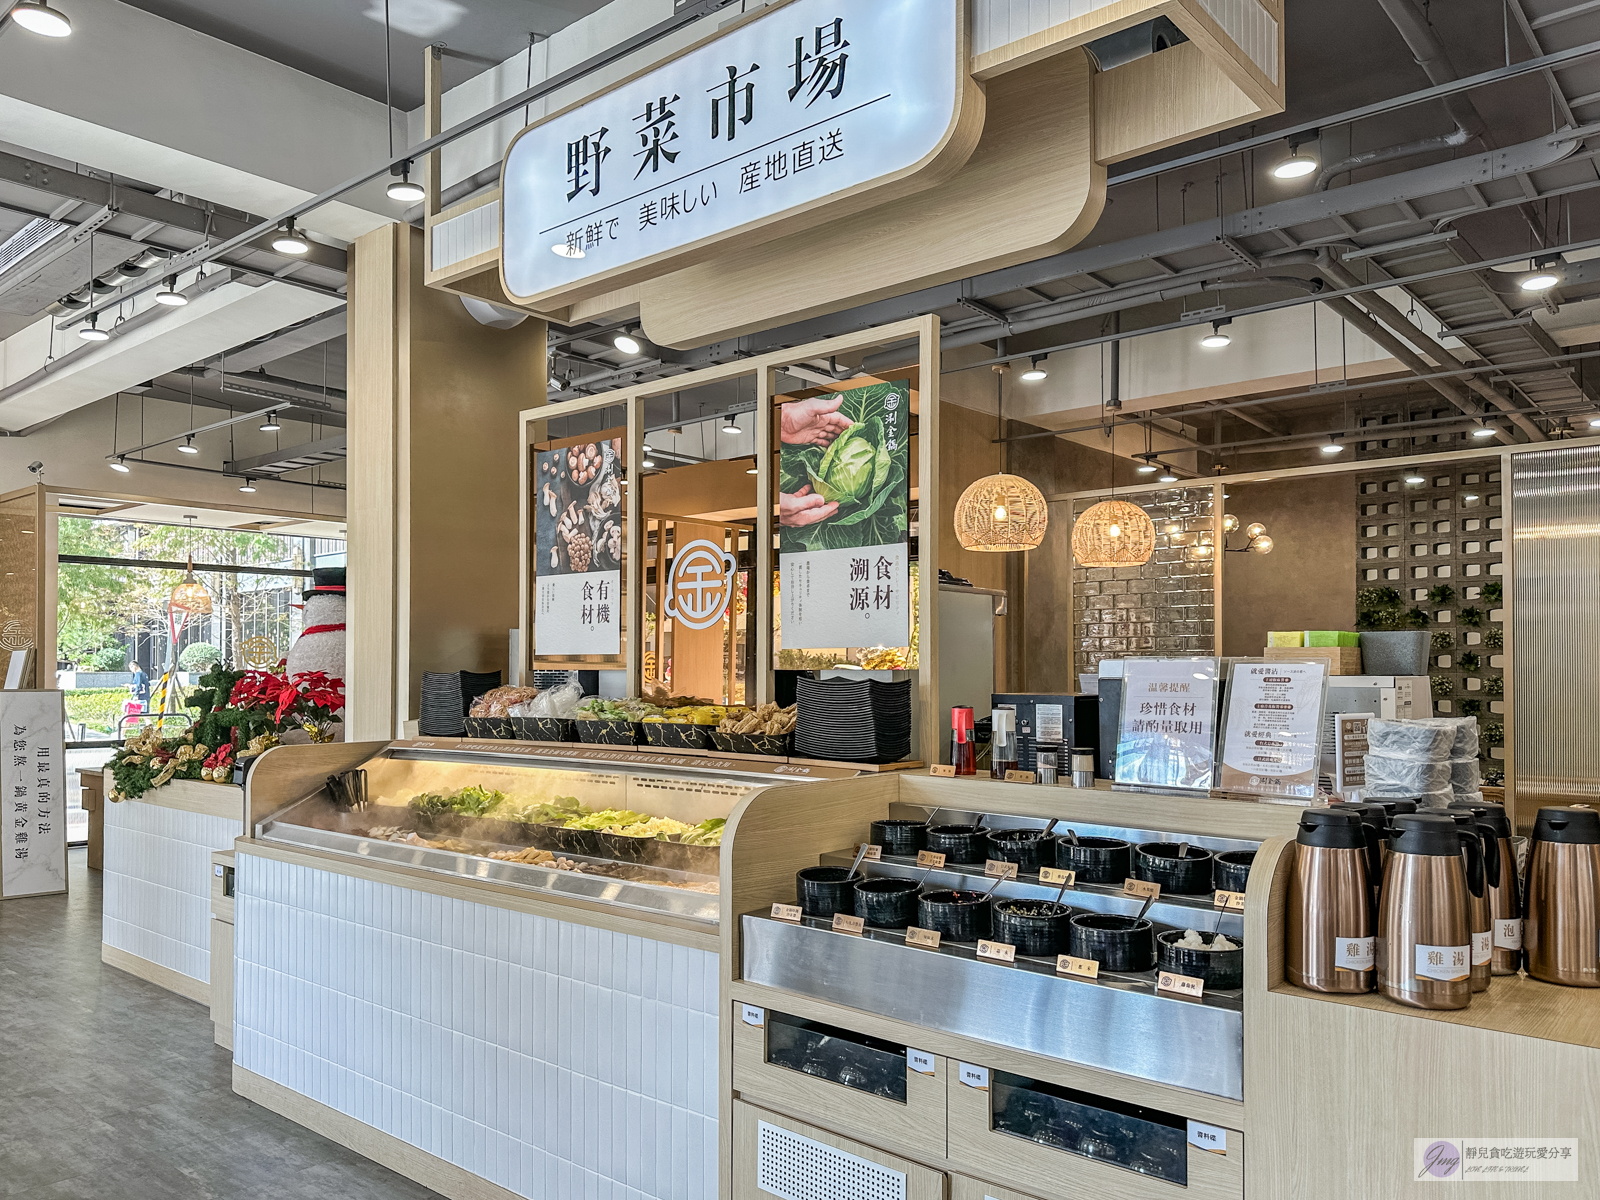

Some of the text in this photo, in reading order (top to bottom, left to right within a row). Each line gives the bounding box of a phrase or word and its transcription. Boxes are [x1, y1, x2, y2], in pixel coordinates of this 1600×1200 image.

[566, 16, 851, 202] 野菜市場
[566, 127, 845, 257] 新鮮で 美味しい 産地直送
[581, 580, 595, 632] 食材。
[597, 579, 610, 624] 有機
[849, 557, 871, 620] 溯源。
[872, 555, 894, 610] 食材
[1131, 719, 1203, 735] 請酌量取用
[1140, 702, 1197, 717] 珍惜食材
[1427, 951, 1465, 967] 雞湯
